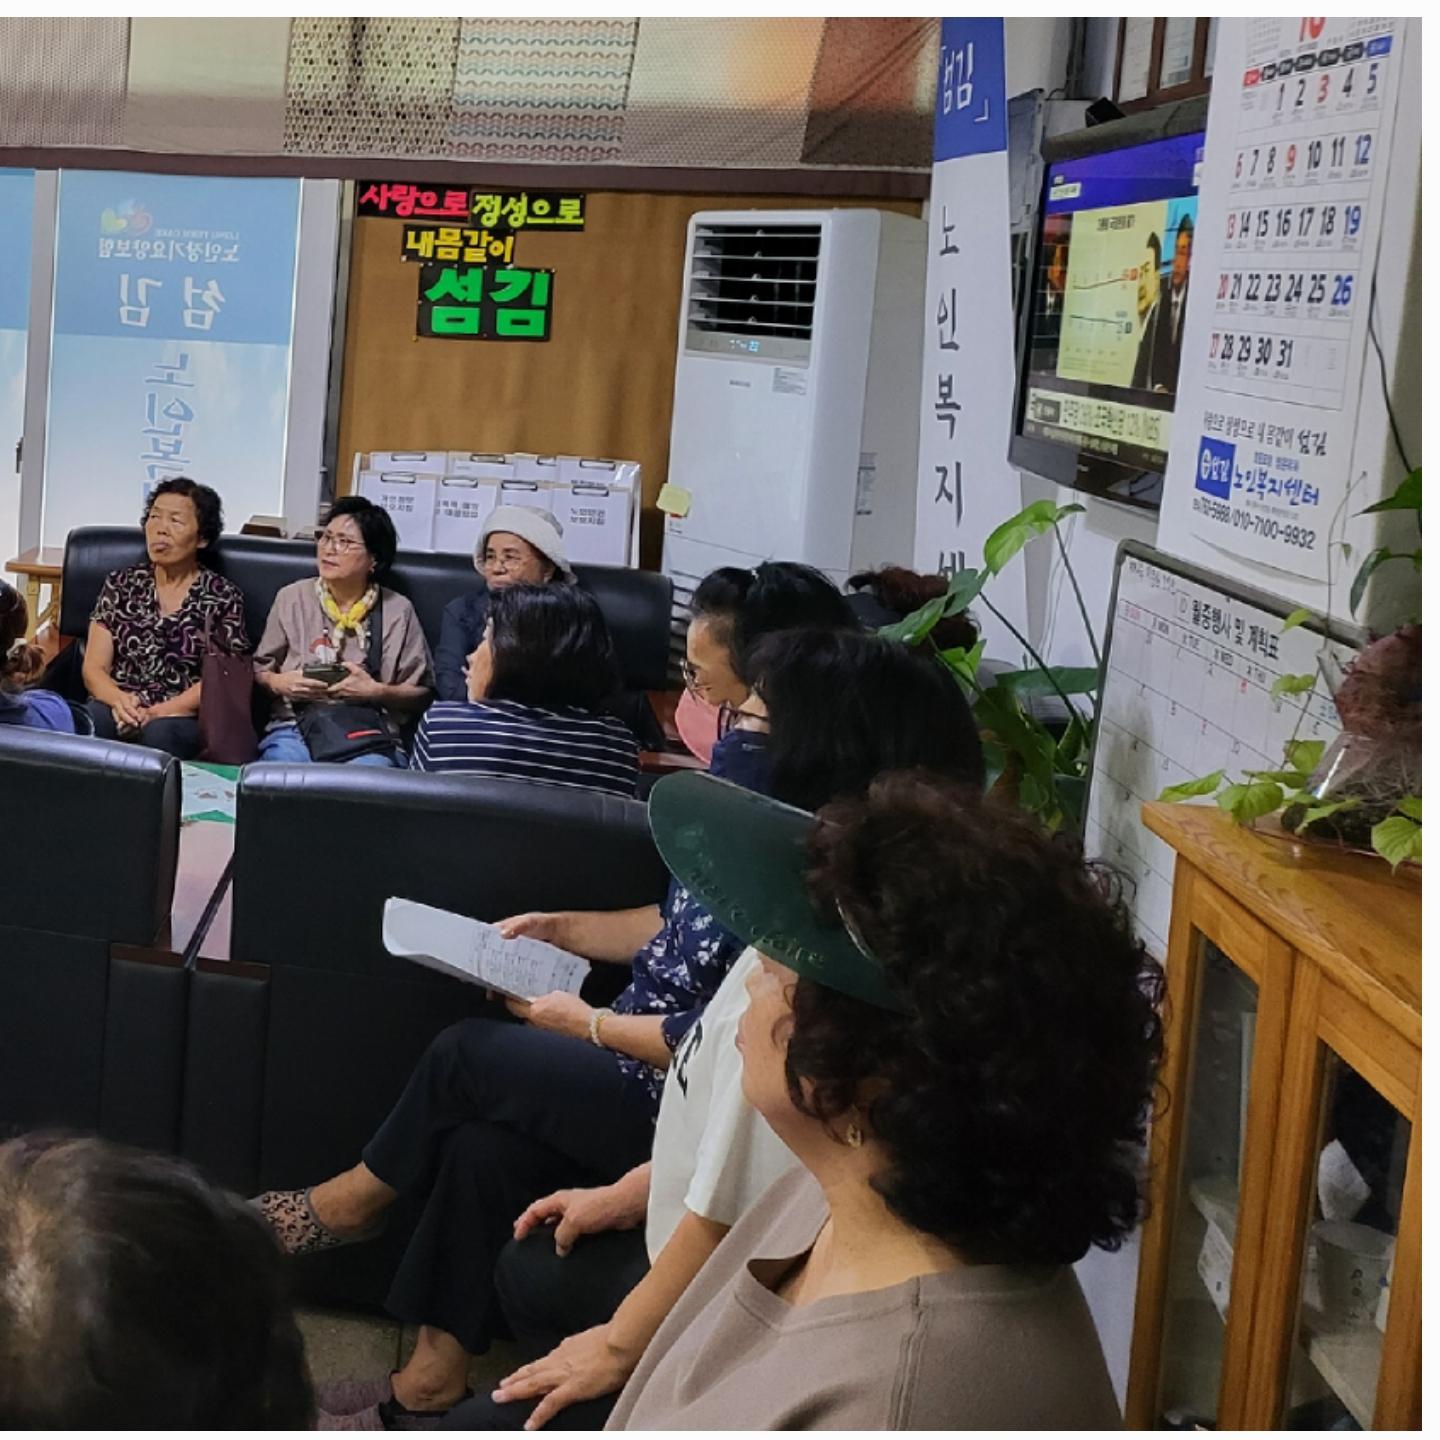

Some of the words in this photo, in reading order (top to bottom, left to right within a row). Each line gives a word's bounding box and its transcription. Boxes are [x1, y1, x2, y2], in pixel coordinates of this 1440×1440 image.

[1276, 83, 1286, 111] 1
[1294, 79, 1306, 107] 2
[1317, 74, 1330, 103] 3
[1342, 68, 1355, 98] 4
[1366, 63, 1379, 94] 5
[1234, 152, 1244, 179] 6
[1249, 149, 1259, 176] 7
[1266, 146, 1277, 174] 8
[1285, 144, 1297, 172] 9
[1307, 140, 1322, 170] 10
[1330, 136, 1346, 168] 11
[1353, 133, 1372, 166] 12
[361, 183, 469, 217] 사랑으로
[471, 191, 584, 227] 정성으로
[1226, 213, 1237, 240] 13
[1239, 210, 1251, 239] 14
[1255, 209, 1270, 238] 15
[1275, 208, 1292, 237] 16
[1296, 206, 1315, 237] 17
[1319, 206, 1336, 236] 18
[1343, 205, 1361, 236] 19
[406, 227, 514, 264] 내몸같이
[424, 267, 550, 337] 섬김
[1230, 273, 1242, 300] 21
[1244, 273, 1260, 301] 22
[1263, 273, 1281, 302] 23
[1284, 274, 1302, 302] 24
[1307, 274, 1327, 304] 25
[1330, 275, 1353, 306] 26
[1220, 333, 1234, 360] 28
[1237, 334, 1251, 362] 29
[1255, 337, 1273, 366] 30
[1276, 339, 1293, 368] 31
[934, 205, 965, 577] 노인복지
[1233, 464, 1320, 506] 노인복지센터
